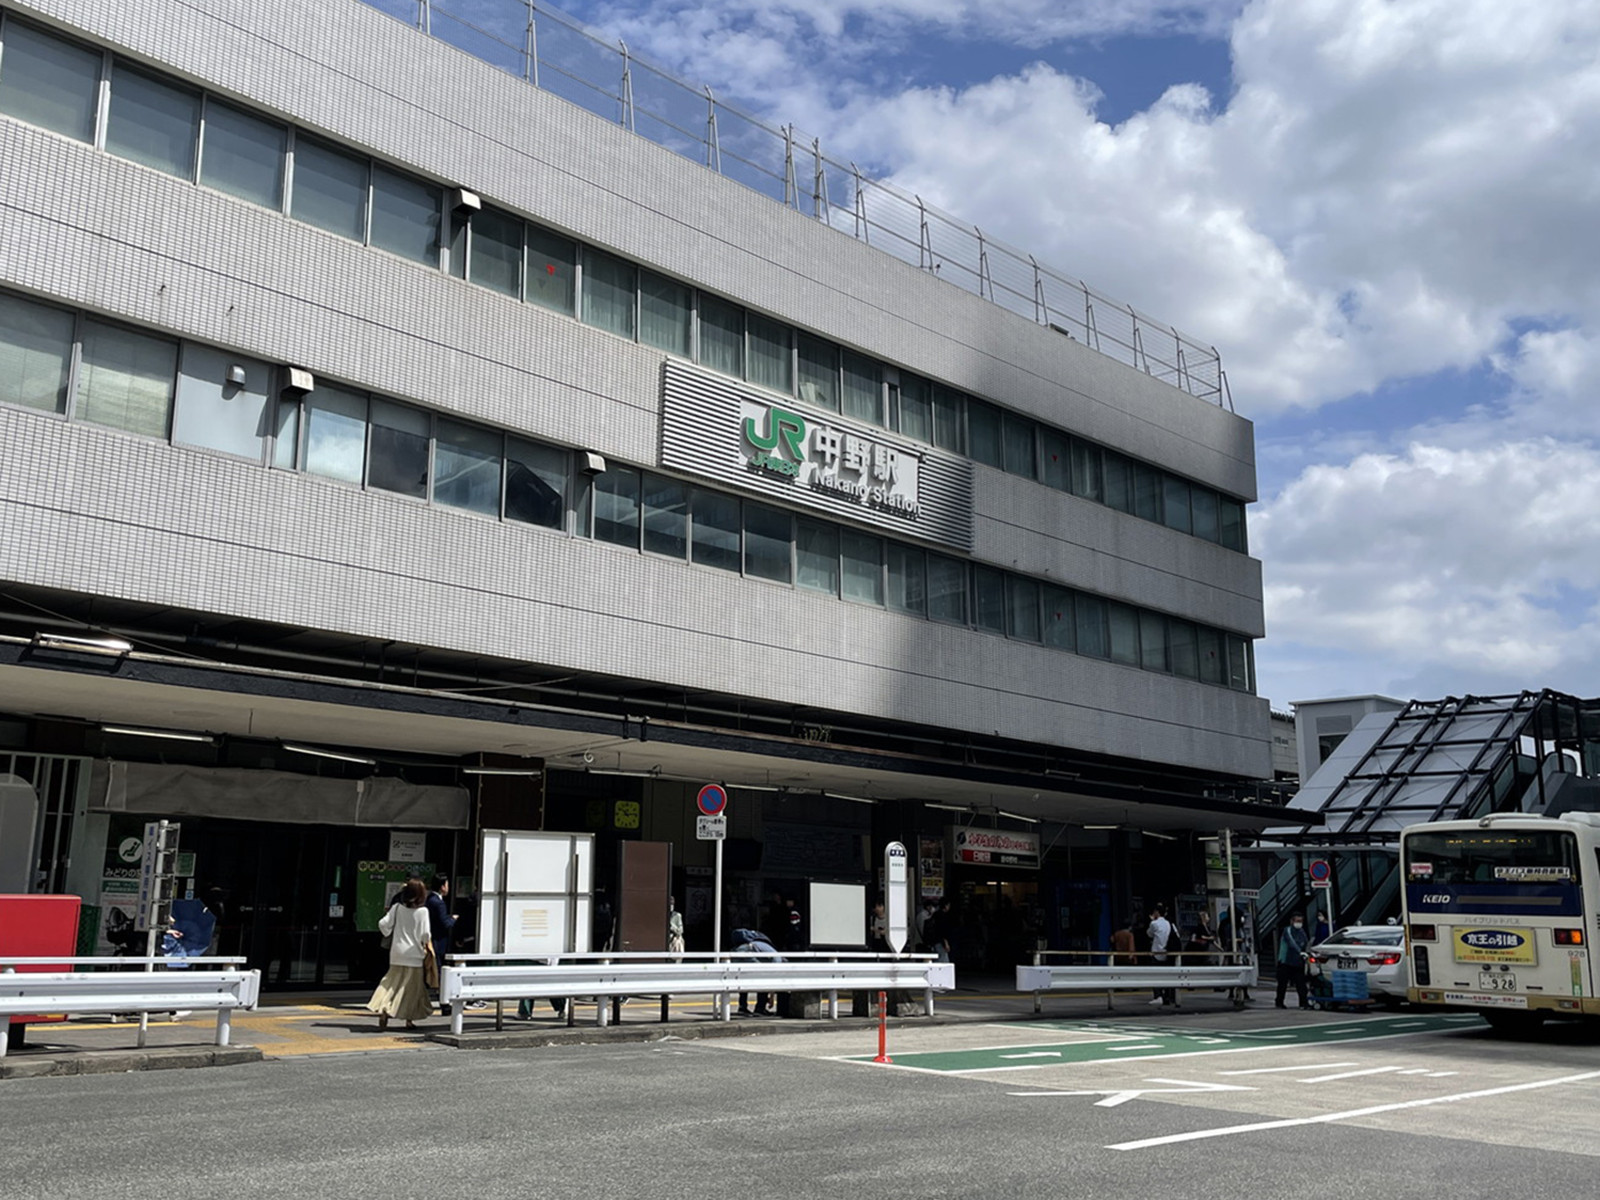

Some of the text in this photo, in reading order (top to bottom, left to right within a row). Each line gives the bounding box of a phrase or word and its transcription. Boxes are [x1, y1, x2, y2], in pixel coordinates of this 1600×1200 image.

[747, 407, 807, 461] JR
[815, 425, 900, 483] 中野駅
[815, 469, 921, 515] Nakano Station
[1423, 895, 1450, 903] KEIO
[1467, 933, 1518, 946] 京王の引越
[1568, 951, 1586, 959] 928
